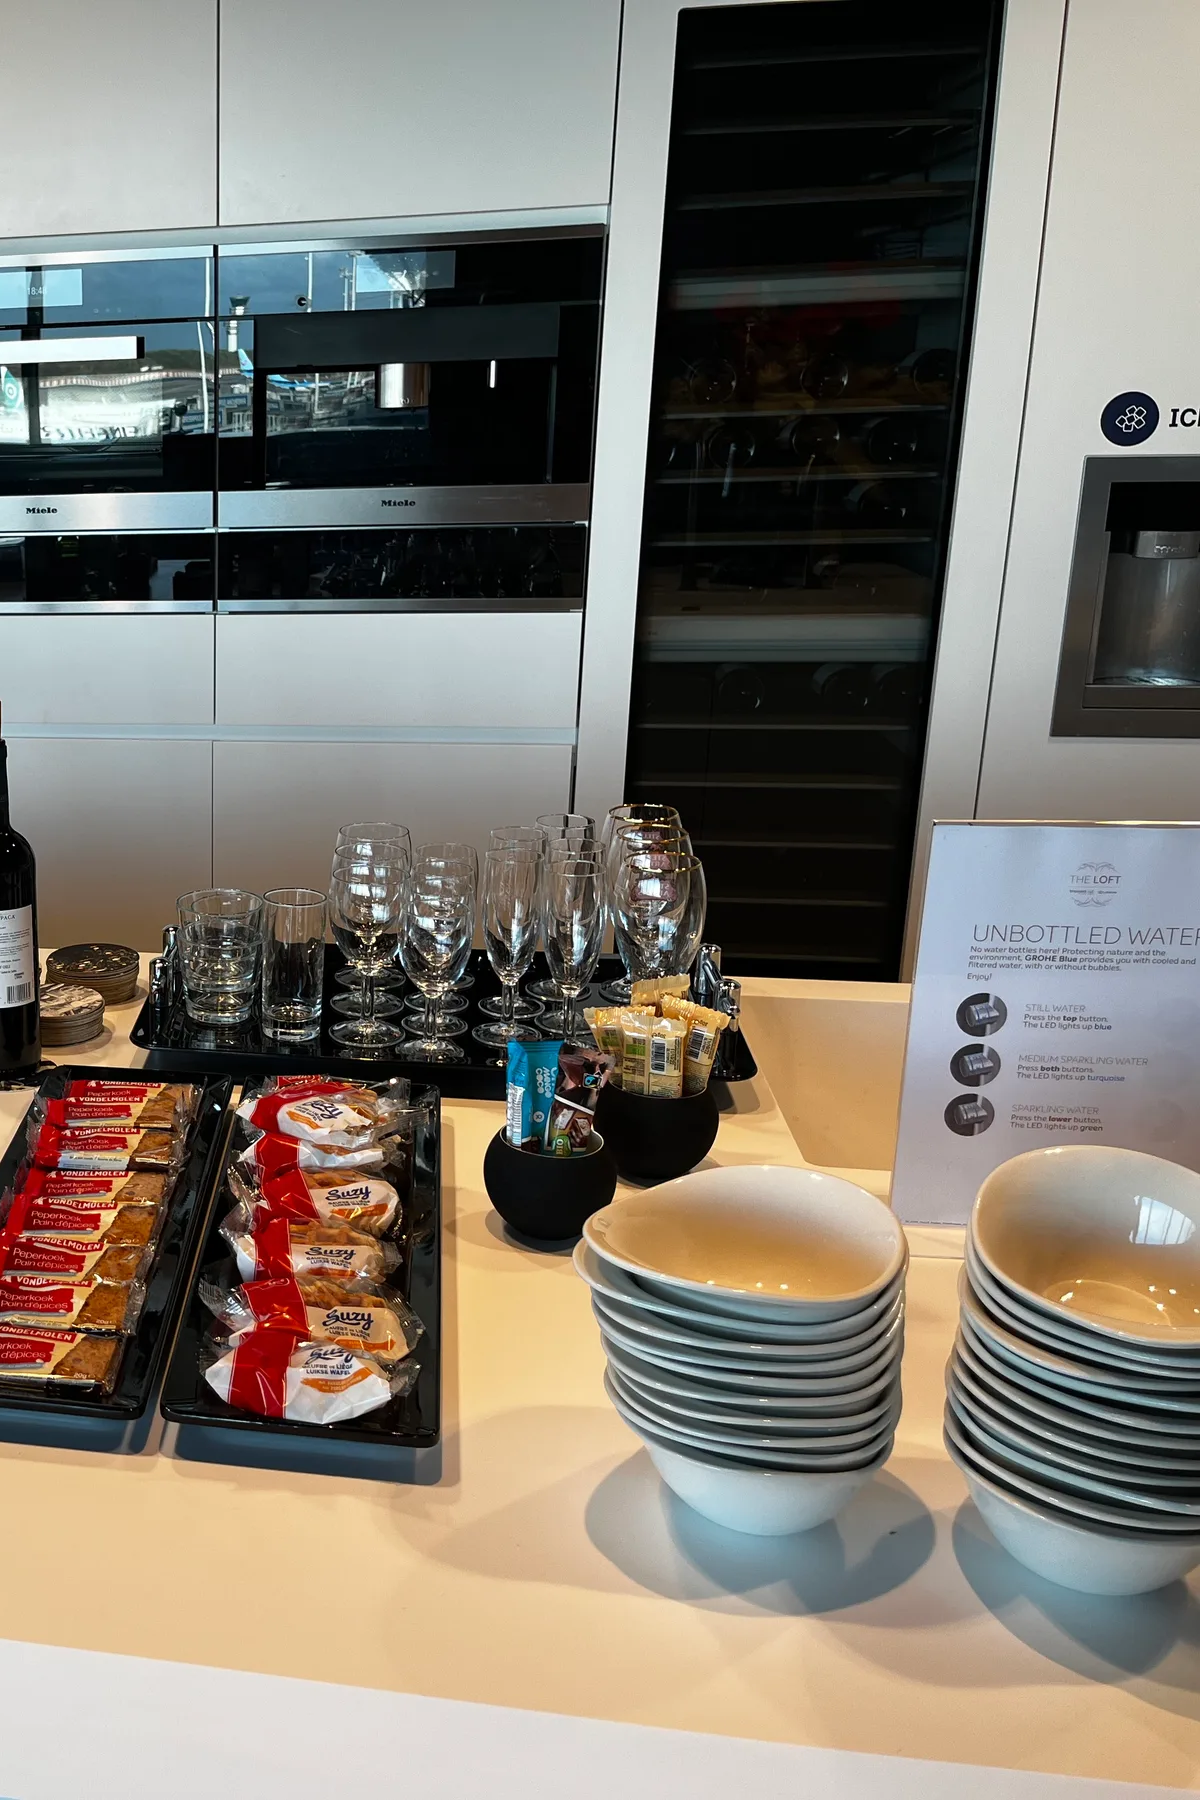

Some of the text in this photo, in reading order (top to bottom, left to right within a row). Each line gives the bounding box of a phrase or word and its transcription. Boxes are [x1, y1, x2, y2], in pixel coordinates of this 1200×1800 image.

[1169, 407, 1200, 428] IC
[381, 498, 416, 508] Miele
[26, 506, 58, 515] Miele
[1070, 875, 1122, 884] THE LOFT
[973, 924, 1122, 945] UNBOTTLED
[970, 945, 982, 953] No
[984, 946, 1007, 954] water
[1008, 946, 1037, 954] bottles
[1039, 947, 1060, 955] here!
[1062, 948, 1104, 957] Protecting
[1152, 949, 1166, 957] the
[1025, 954, 1057, 962] GROHE
[1059, 955, 1077, 963] Blue
[1079, 956, 1114, 964] provides
[1116, 957, 1132, 965] you
[1152, 957, 1179, 965] cooled
[1180, 957, 1197, 965] and
[968, 961, 997, 969] filtered
[1055, 963, 1086, 971] without
[1088, 964, 1121, 972] bubbles.
[967, 973, 992, 981] Enjoy!
[1025, 1003, 1086, 1013] STILL WATER
[1024, 1013, 1045, 1021] Press
[1023, 1021, 1038, 1029] The
[1040, 1021, 1056, 1029] LED
[1058, 1022, 1080, 1031] lights
[1082, 1023, 1093, 1031] up
[1018, 1055, 1149, 1066] MEDIUM SPARKLING WATER
[1017, 1064, 1039, 1072] Press
[535, 1067, 544, 1094] COCO
[1033, 1072, 1049, 1080] LED
[1051, 1073, 1073, 1081] lights
[1087, 1074, 1126, 1082] turquoise
[99, 1080, 160, 1088] VONDELMOLEN
[1011, 1104, 1100, 1115] SPARKLING WATER
[1010, 1121, 1025, 1129] The
[1044, 1122, 1067, 1131] lights
[74, 1128, 138, 1136] VONDELMOLEN
[325, 1186, 372, 1201] Suzy
[48, 1198, 115, 1209] VONDELMOLEN
[30, 1210, 82, 1222] Peperkoek
[32, 1218, 54, 1226] Pain
[31, 1236, 101, 1251] VONDELMOLEN
[12, 1247, 66, 1262] Peperkoek
[304, 1246, 356, 1260] Suzy
[14, 1258, 36, 1267] Pain
[0, 1300, 69, 1309] Pain d'épices
[322, 1309, 374, 1331] Suzy
[0, 1350, 46, 1360] d'épices
